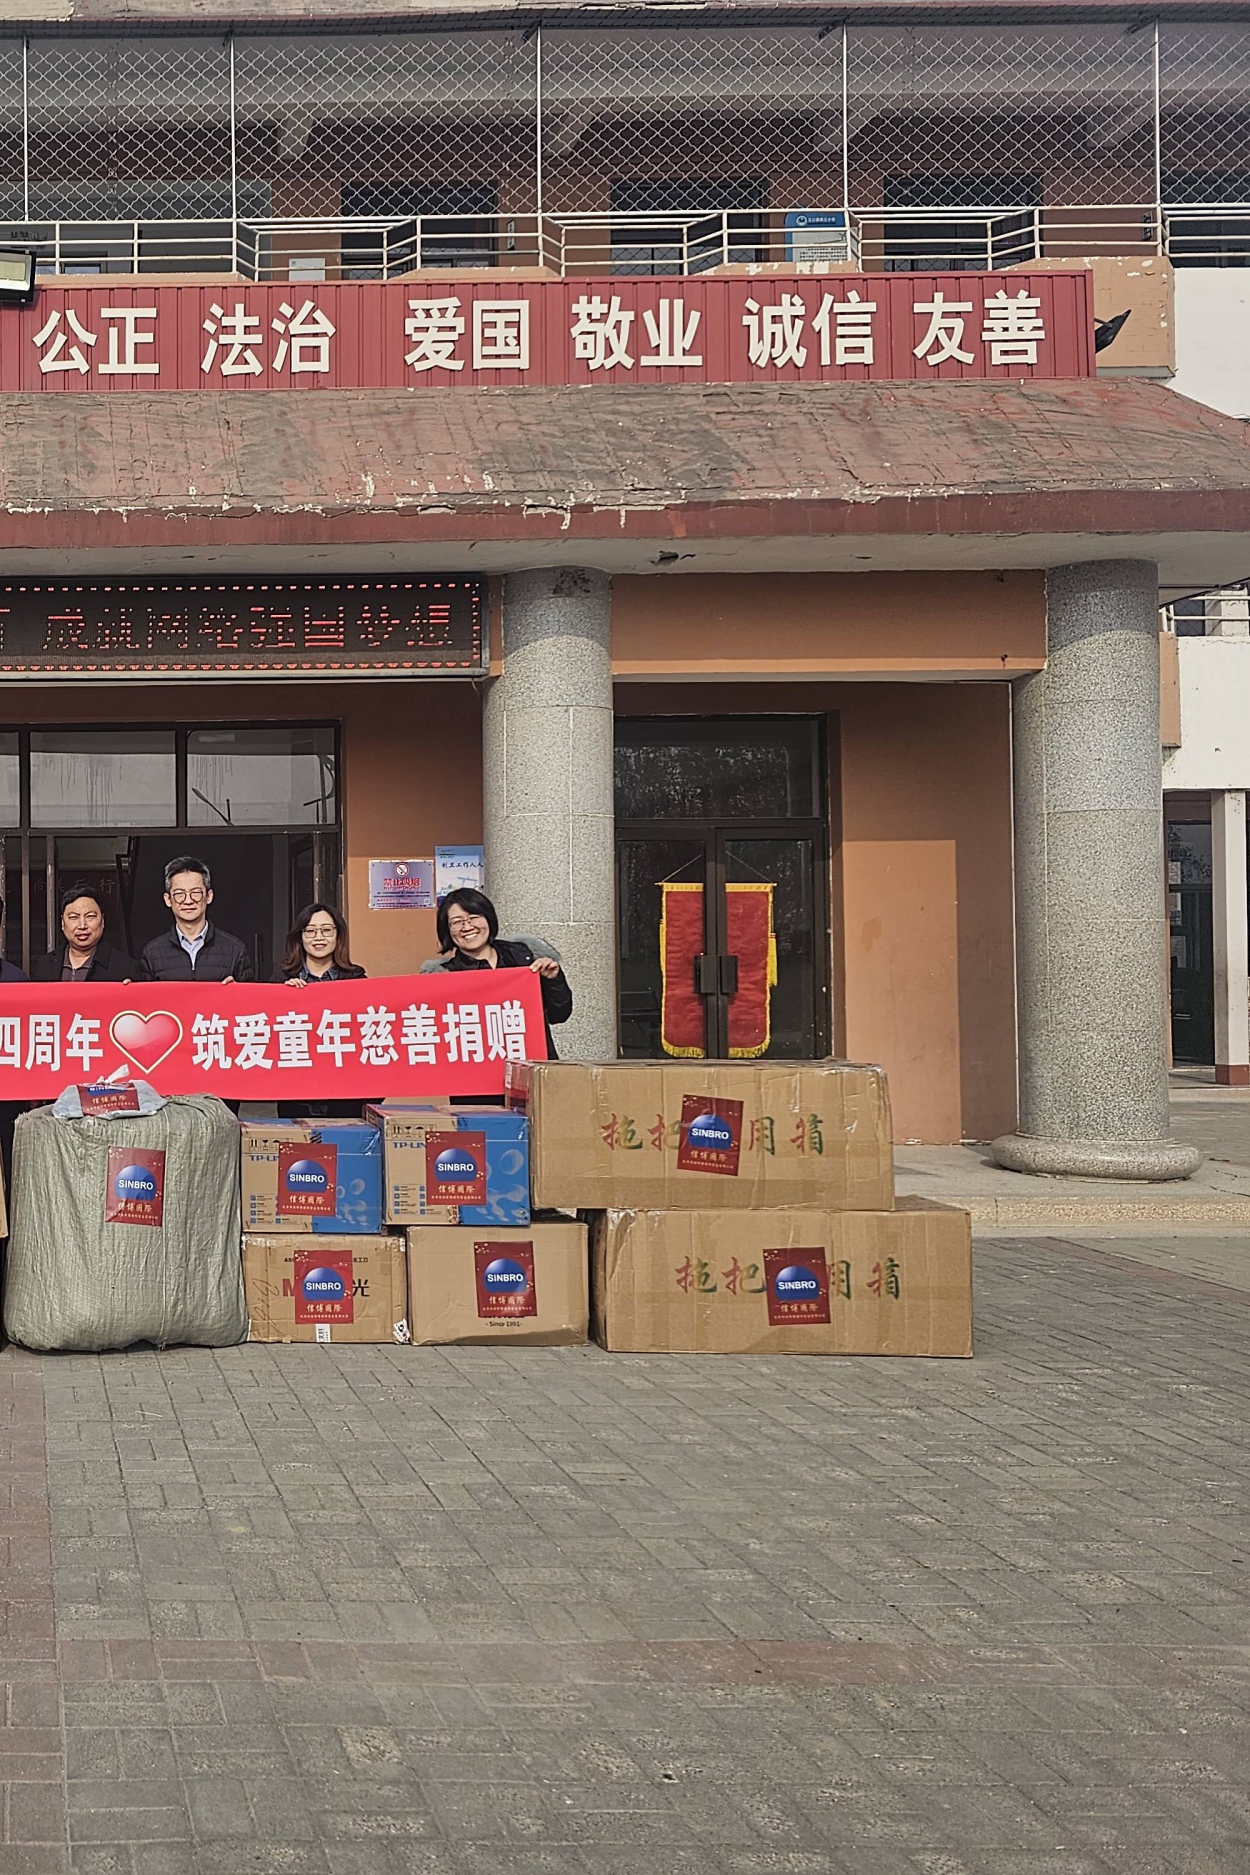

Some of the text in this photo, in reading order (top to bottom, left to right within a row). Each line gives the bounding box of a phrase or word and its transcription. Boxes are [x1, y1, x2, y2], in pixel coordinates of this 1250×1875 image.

[32, 308, 160, 374] 公正
[201, 300, 336, 376] 法治
[404, 296, 531, 372] 爱国
[571, 295, 703, 370] 敬业
[742, 291, 877, 367] 诚信
[913, 289, 1046, 366] 友善
[191, 1000, 527, 1071] 筑爱童年慈善捐赠
[692, 1127, 729, 1140] SINBRO
[437, 1163, 474, 1172] SINBRO
[289, 1173, 325, 1183] SINBRO
[118, 1179, 154, 1191] SINBRO
[487, 1273, 524, 1282] SINBRO
[306, 1281, 342, 1291] SINBRO
[778, 1280, 817, 1290] SINBRO
